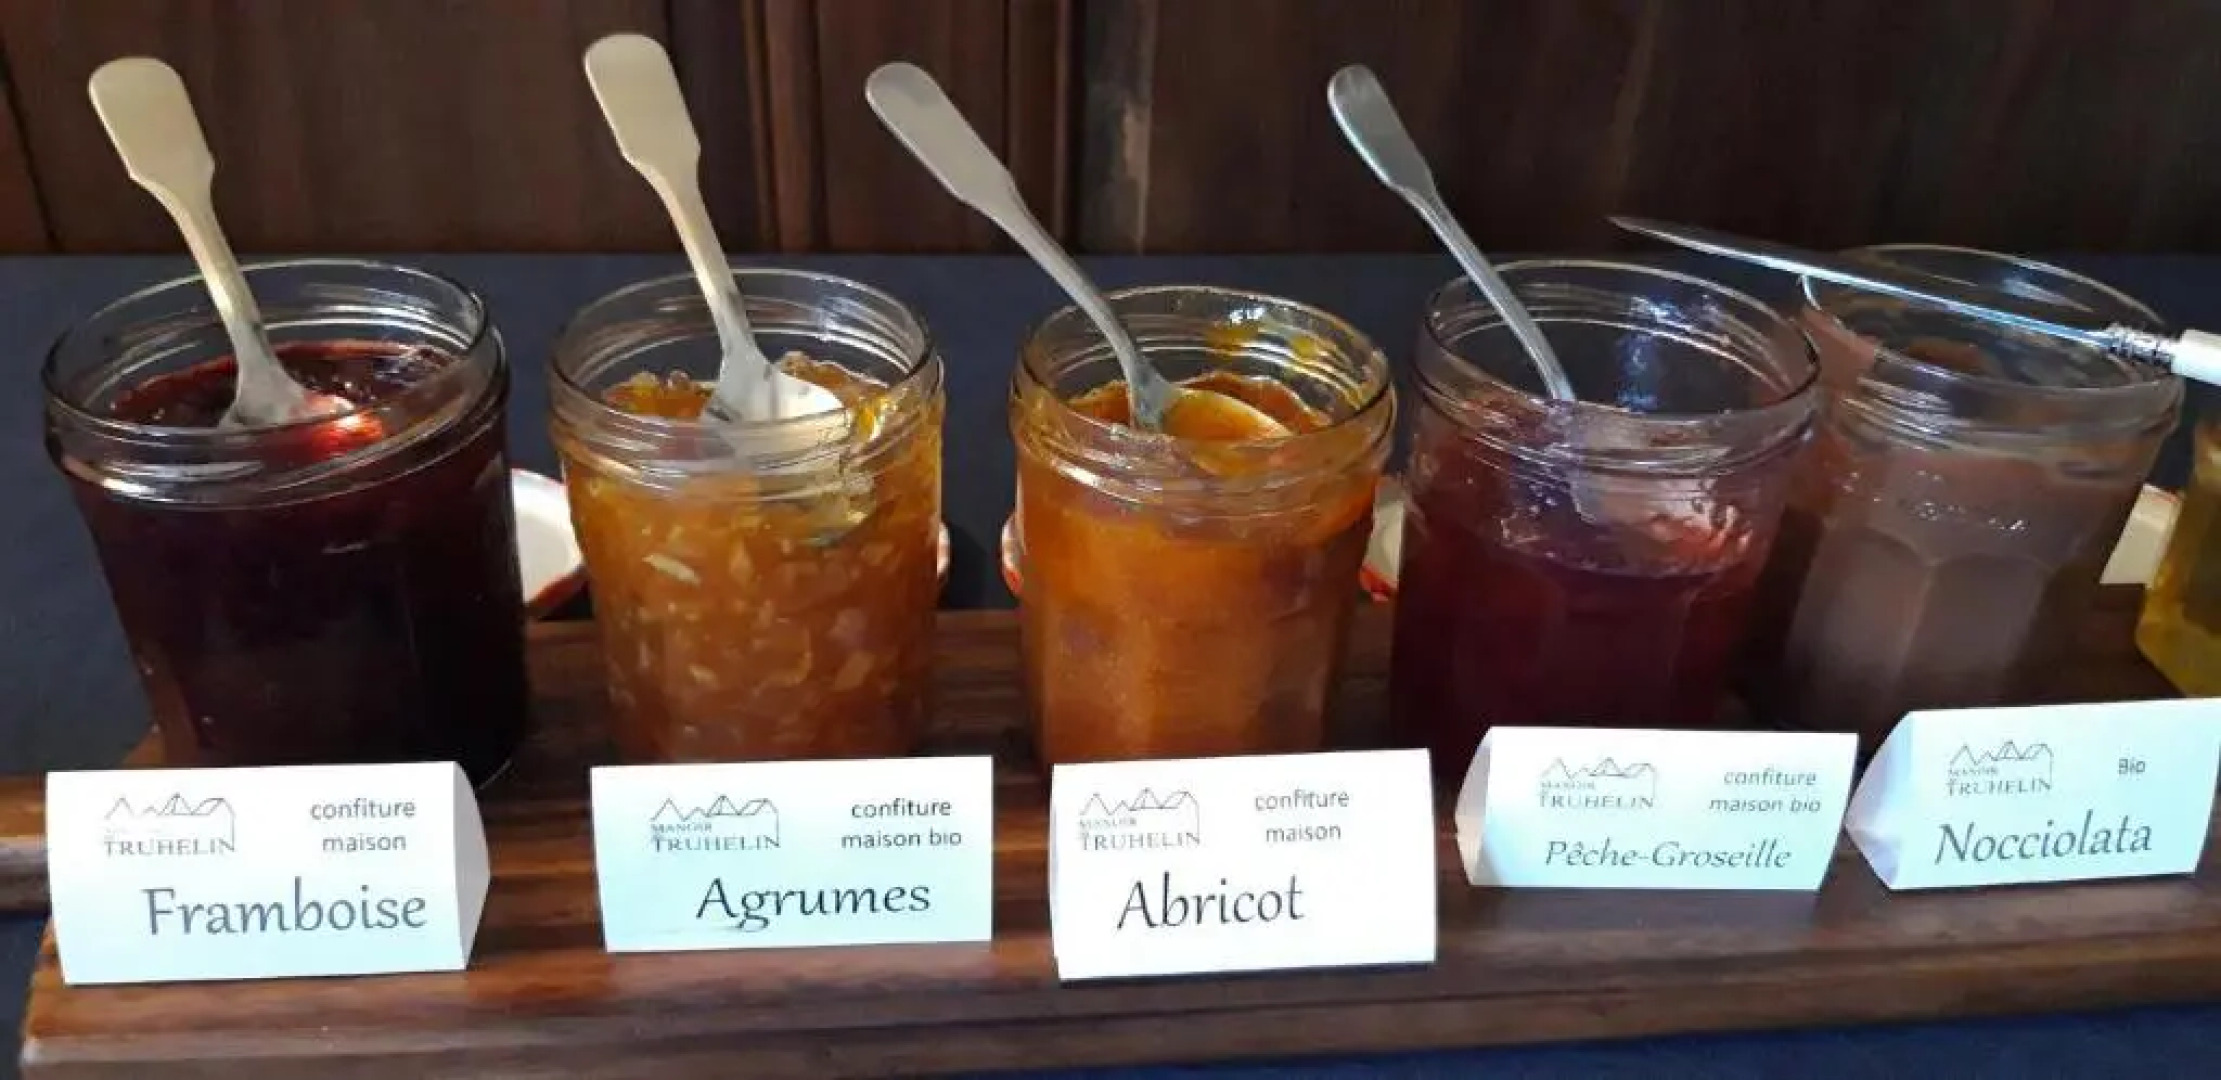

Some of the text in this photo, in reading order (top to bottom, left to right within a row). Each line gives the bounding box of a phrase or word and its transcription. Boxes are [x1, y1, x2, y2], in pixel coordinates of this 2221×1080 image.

[1723, 767, 1816, 787] confiture
[2117, 757, 2146, 775] Bio
[309, 798, 417, 821] confiture
[851, 798, 952, 819] confiture
[1255, 787, 1350, 811] confiture
[1709, 797, 1820, 813] maison bio
[322, 832, 407, 853] maison
[841, 826, 962, 850] maison bio
[1266, 822, 1342, 843] maison
[1935, 809, 2152, 865] Nocciolata
[103, 838, 236, 857] TRUHELIN
[651, 835, 781, 853] TRUHELIN
[1545, 836, 1793, 868] Pêche-Groseille
[141, 876, 428, 936] Framboise
[695, 876, 931, 932] Agrumes
[1116, 870, 1305, 931] Abricot
